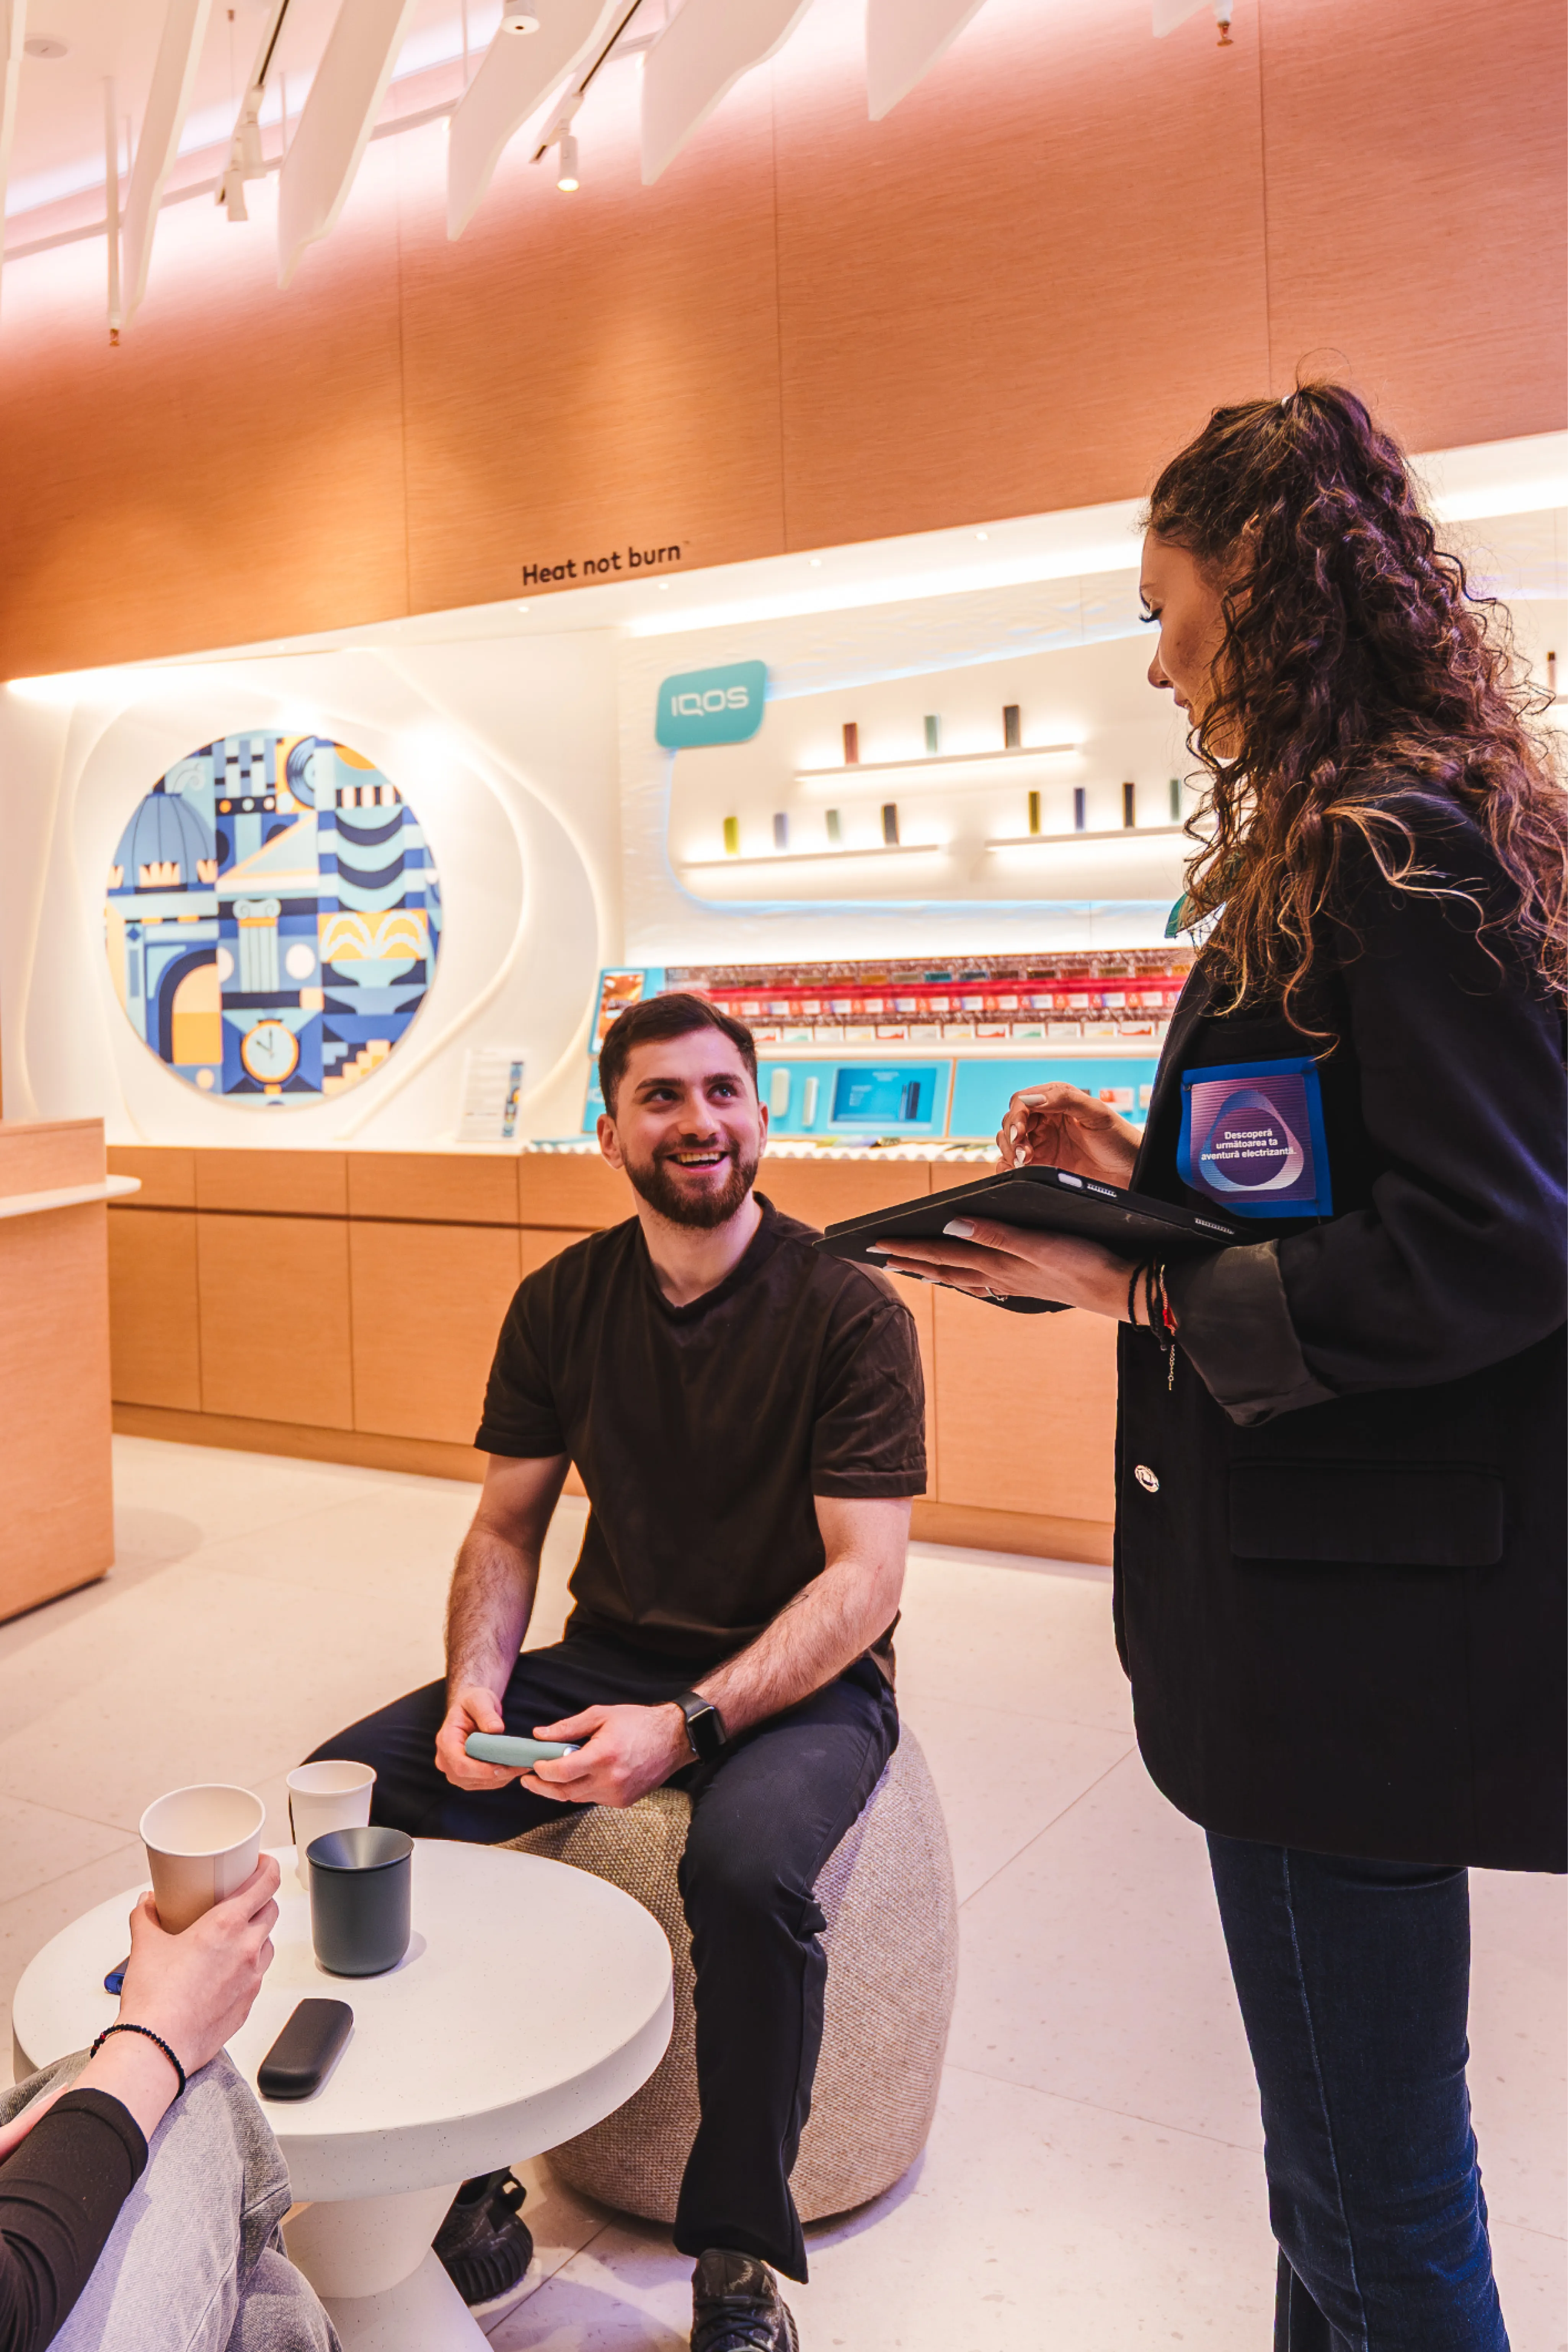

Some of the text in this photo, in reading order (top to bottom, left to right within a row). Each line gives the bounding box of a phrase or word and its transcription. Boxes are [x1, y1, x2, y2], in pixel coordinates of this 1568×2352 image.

[522, 545, 681, 586] Heat not burn
[671, 686, 749, 717] IQOS
[1224, 1128, 1273, 1140] Descoperă
[1268, 1138, 1278, 1146] ta
